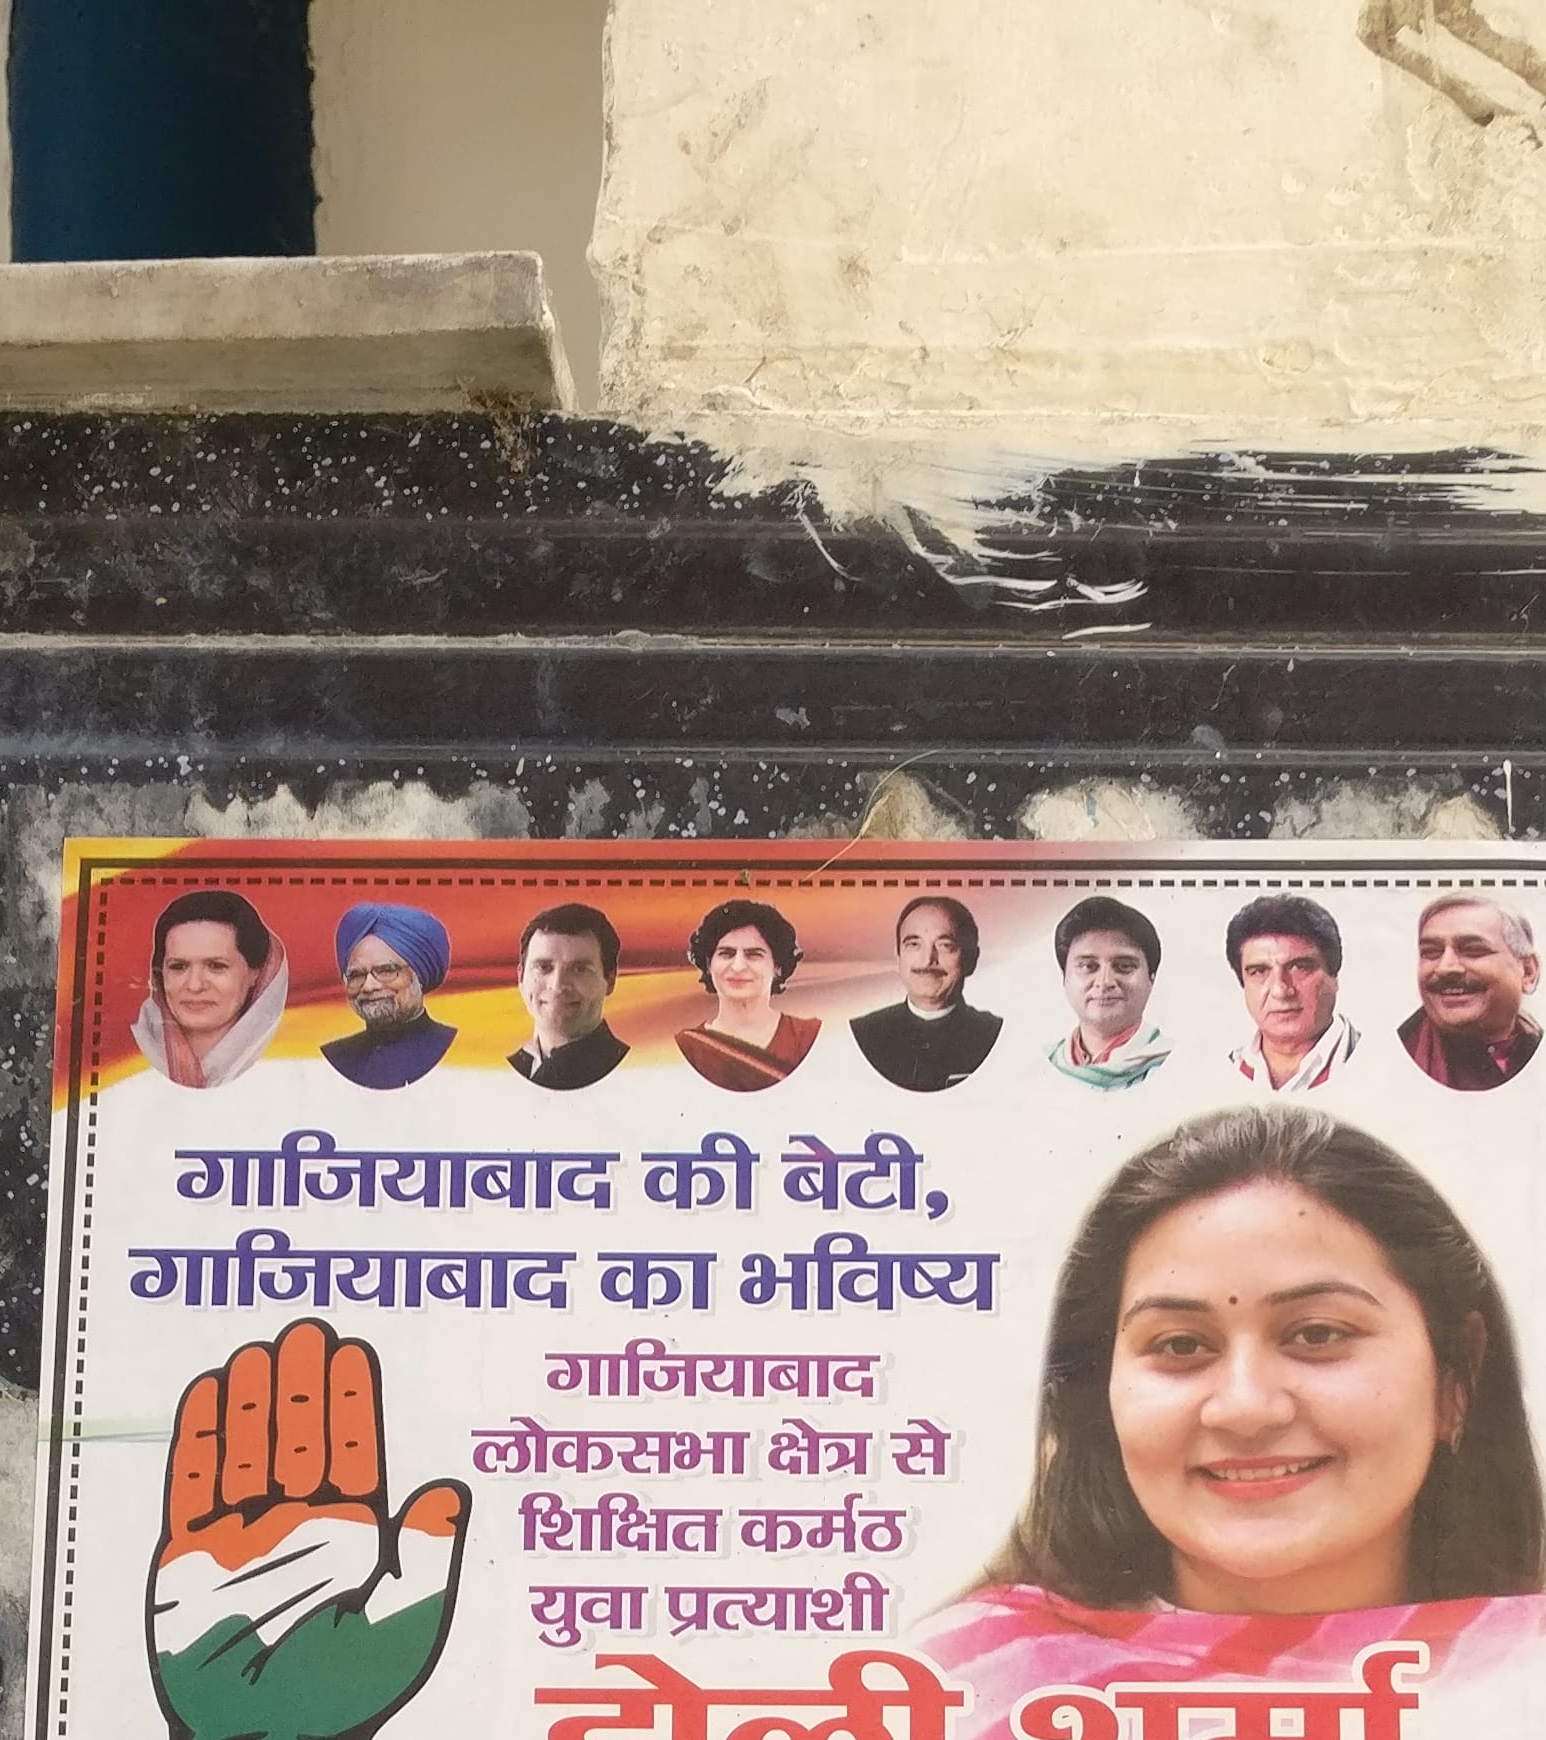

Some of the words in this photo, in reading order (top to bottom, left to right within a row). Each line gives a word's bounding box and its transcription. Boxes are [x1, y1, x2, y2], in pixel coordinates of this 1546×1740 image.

[175, 1130, 620, 1211] गाजियाबाद
[642, 1132, 759, 1211] की
[781, 1132, 949, 1221] बेटी,
[128, 1229, 577, 1309] गाजियाबाद
[599, 1252, 714, 1310] का
[738, 1233, 999, 1312] भविष्य
[545, 1339, 880, 1397] गाजियाबाद
[470, 1417, 746, 1476] लोकसभा
[767, 1418, 870, 1477] क्षेत्र
[889, 1418, 951, 1477] से
[518, 1491, 717, 1552] शिक्षित
[739, 1492, 905, 1553] कर्मठ
[528, 1584, 648, 1647] युवा
[666, 1573, 888, 1632] प्रत्याशी
